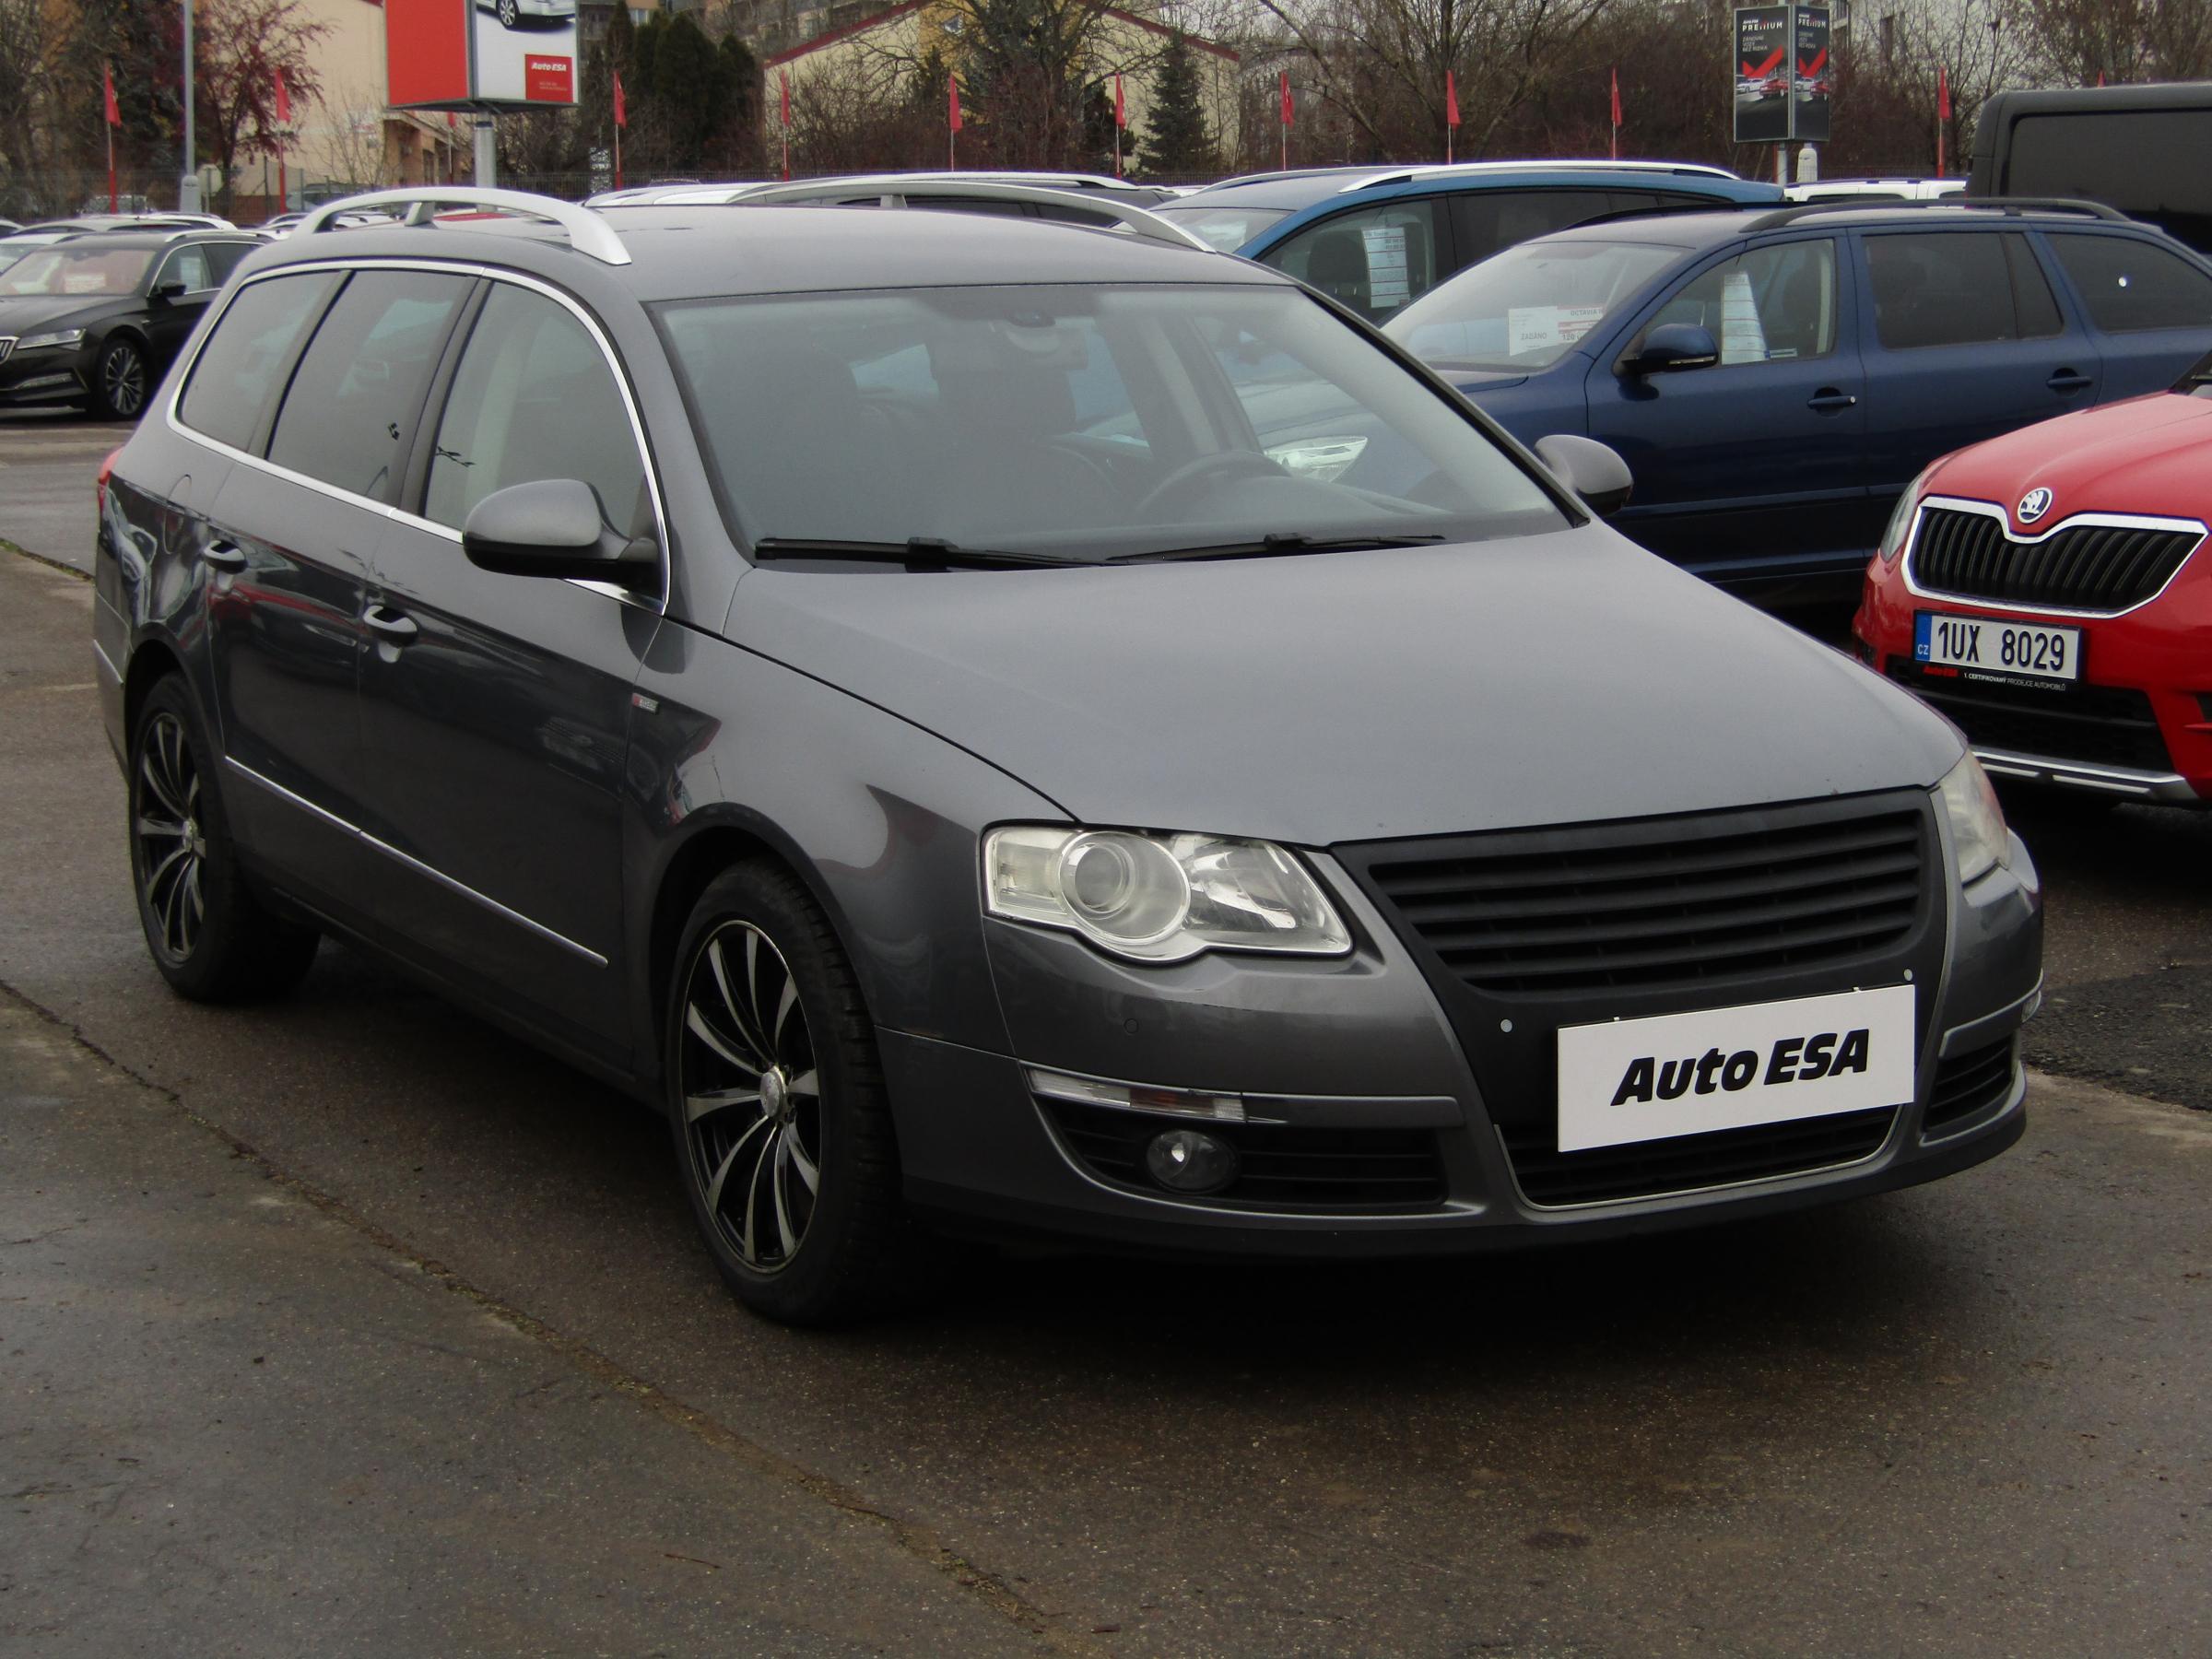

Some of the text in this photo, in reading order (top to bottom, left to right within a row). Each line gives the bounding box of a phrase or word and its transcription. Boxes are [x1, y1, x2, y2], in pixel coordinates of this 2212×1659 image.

[1742, 21, 1783, 32] PREMIUM
[531, 62, 567, 72] Auto ESA
[1570, 308, 1598, 316] OCTAVIA
[1917, 643, 1929, 655] CZ
[1937, 621, 2065, 673] 1UX 8029
[2006, 678, 2033, 688] PRODEJCE
[1609, 1028, 1870, 1107] Auto ESA
